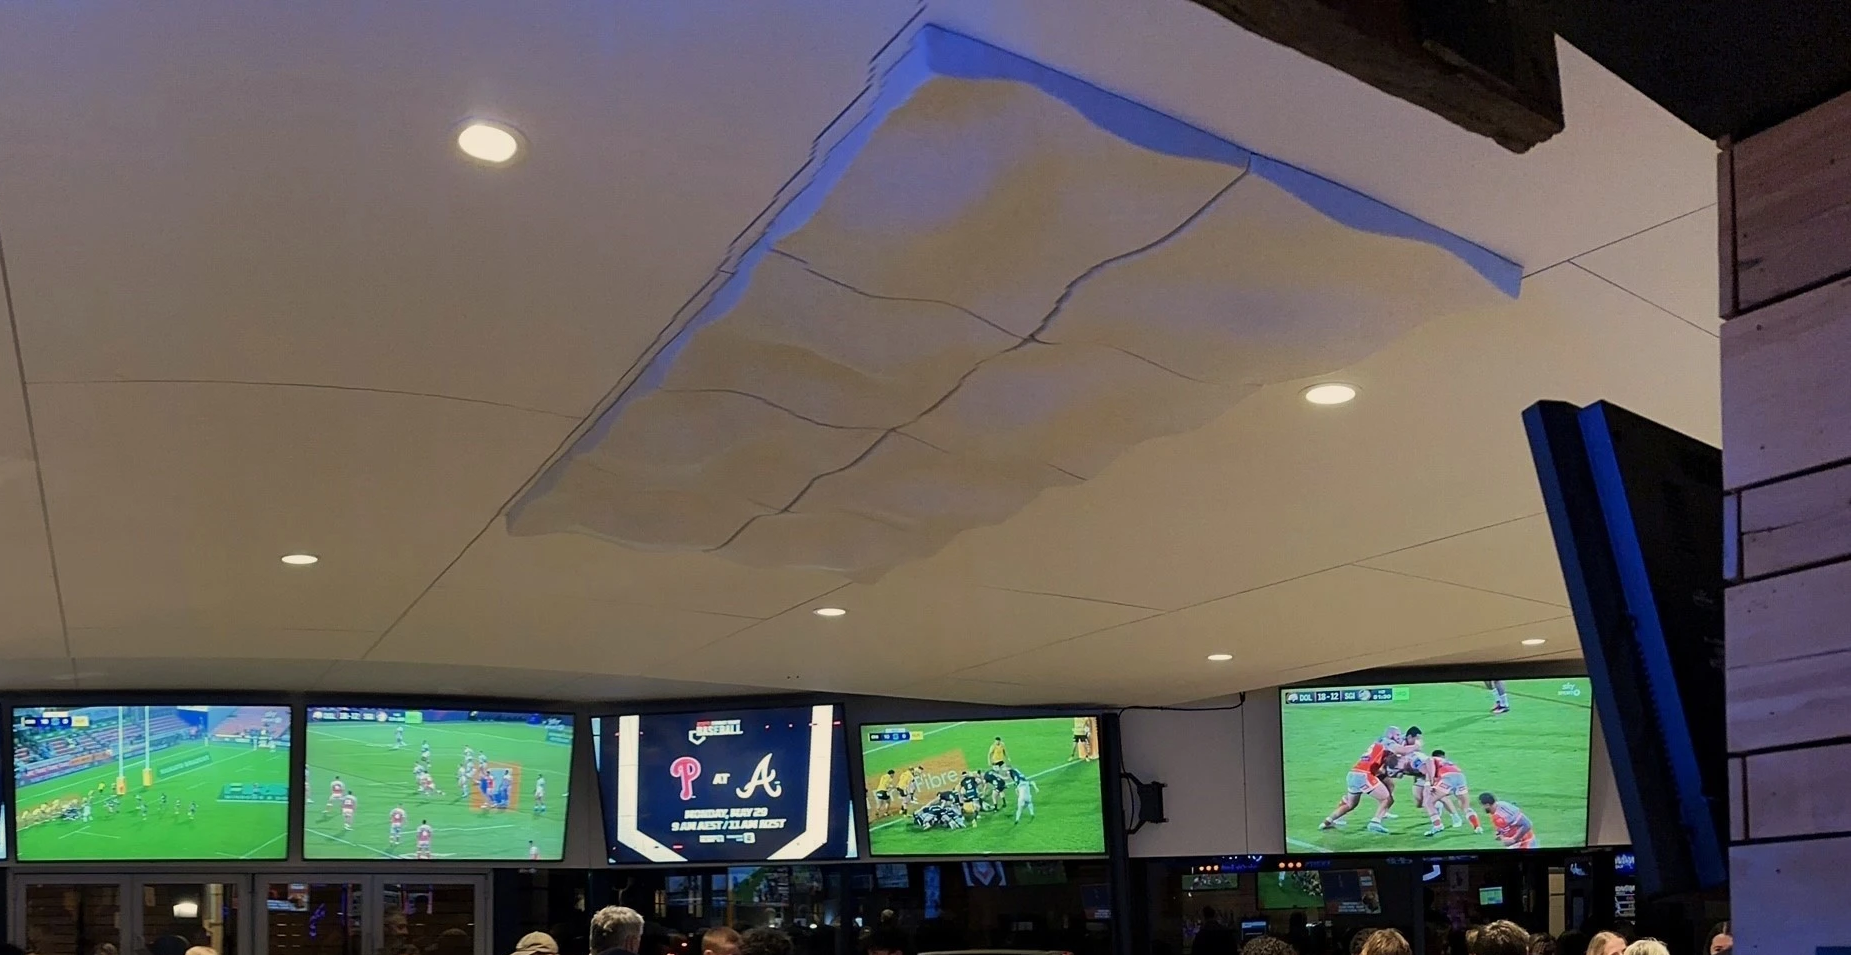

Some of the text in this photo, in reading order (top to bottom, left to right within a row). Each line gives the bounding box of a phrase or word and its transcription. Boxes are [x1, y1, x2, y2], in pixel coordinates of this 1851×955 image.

[1299, 692, 1355, 702] DOL 18-12 SGI
[696, 724, 743, 736] BASEBALL
[712, 772, 731, 785] AT
[914, 770, 958, 793] Fibre
